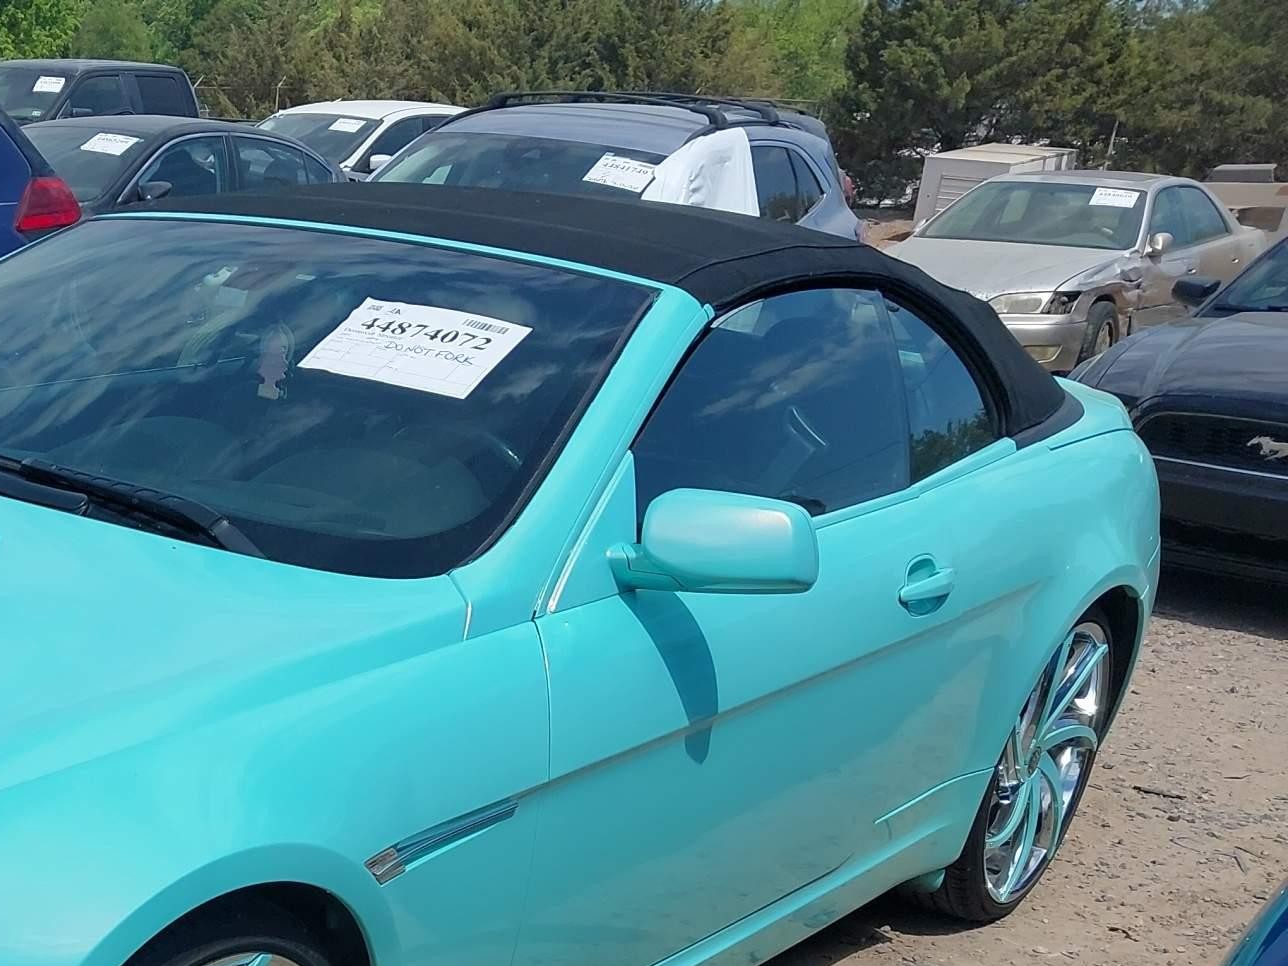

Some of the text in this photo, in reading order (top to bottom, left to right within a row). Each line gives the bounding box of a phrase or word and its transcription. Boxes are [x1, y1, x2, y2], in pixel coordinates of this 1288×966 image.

[361, 317, 493, 351] 44874072
[384, 340, 476, 366] DO NOT FORK
